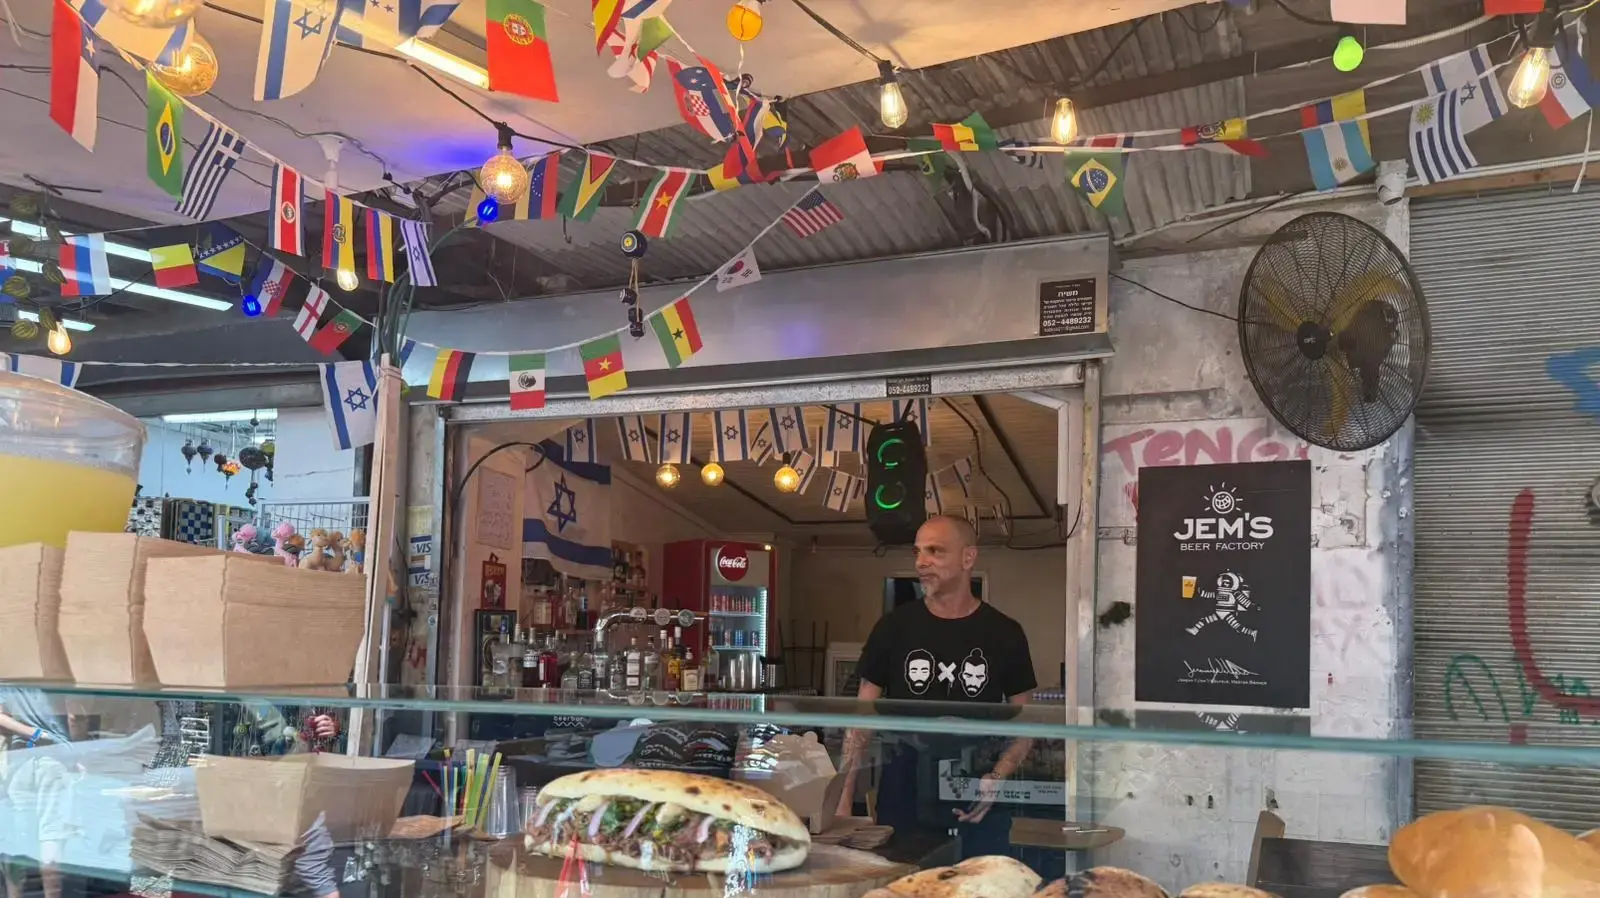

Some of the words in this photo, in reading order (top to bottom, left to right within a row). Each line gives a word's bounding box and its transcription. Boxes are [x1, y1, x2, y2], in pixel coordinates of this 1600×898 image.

[1042, 316, 1092, 327] 052-4489232
[1173, 512, 1274, 540] JEM'S
[416, 543, 432, 553] VIS
[1180, 542, 1211, 551] BEER
[1215, 542, 1265, 551] FACTORY
[719, 556, 747, 568] Coca-Cola
[414, 573, 434, 585] VIS
